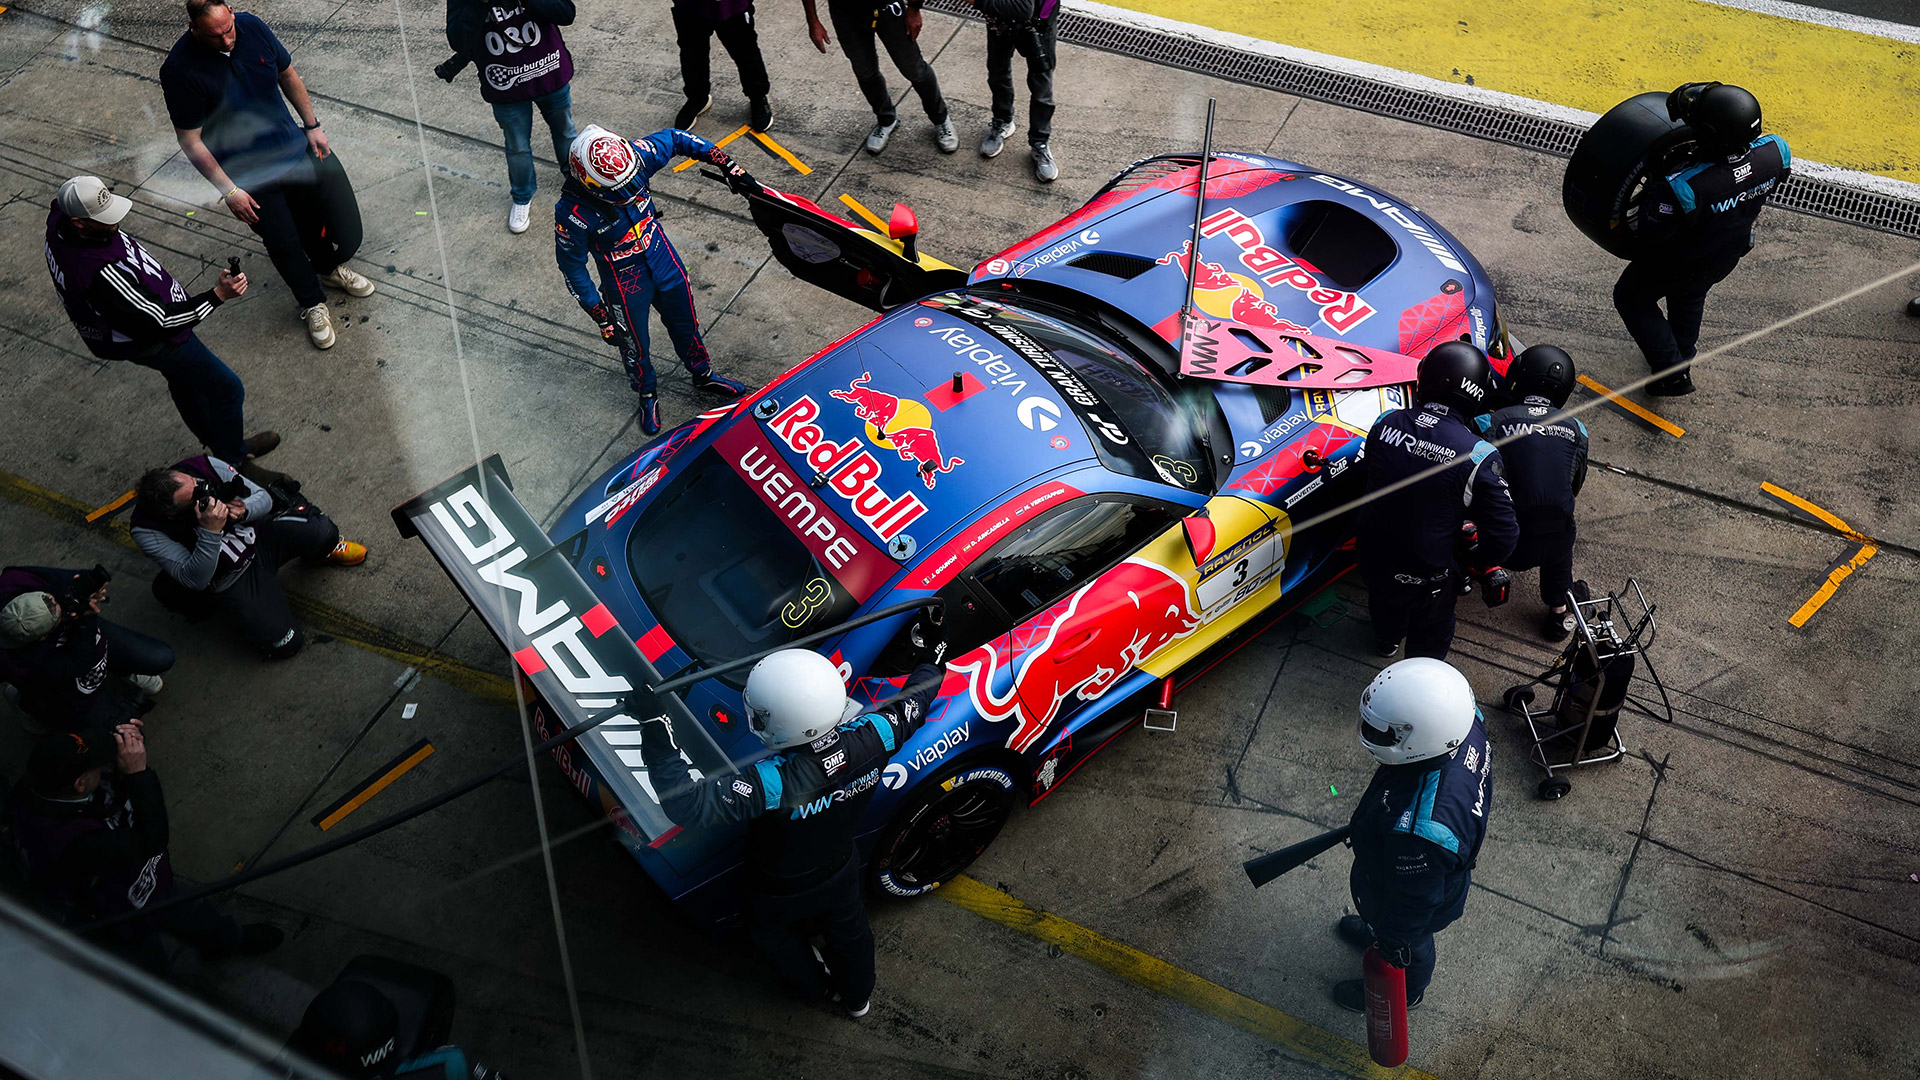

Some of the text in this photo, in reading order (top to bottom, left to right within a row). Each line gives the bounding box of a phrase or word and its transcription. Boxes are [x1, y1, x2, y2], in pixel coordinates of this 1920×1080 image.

[507, 49, 560, 76] nürburgring
[1734, 166, 1752, 178] OMP
[611, 240, 643, 261] Red
[1034, 240, 1082, 268] viaplay
[1262, 267, 1377, 335] Red
[928, 327, 1028, 397] viaplay
[988, 324, 1057, 372] TURISMO
[1050, 368, 1094, 407] GRAN
[1259, 410, 1308, 444] viaplay
[1417, 414, 1439, 426] OMP
[1415, 447, 1453, 465] RACING
[1418, 439, 1457, 459] WINWARD
[768, 395, 928, 543] Red Bull
[1153, 454, 1198, 483] 3
[1330, 459, 1348, 476] OMP
[1288, 481, 1321, 505] RAVENOL
[739, 446, 858, 570] WEMPE
[1204, 527, 1271, 576] RAVENOL
[1232, 559, 1249, 587] 3
[430, 484, 634, 694] AMG
[781, 577, 832, 629] 3
[907, 720, 970, 771] viaplay
[559, 746, 592, 798] Bull
[824, 752, 845, 771] OMP
[732, 781, 753, 795] OMP
[846, 776, 880, 798] RACING
[966, 769, 1012, 789] MICHELIN
[881, 874, 921, 896] MICHELIN
